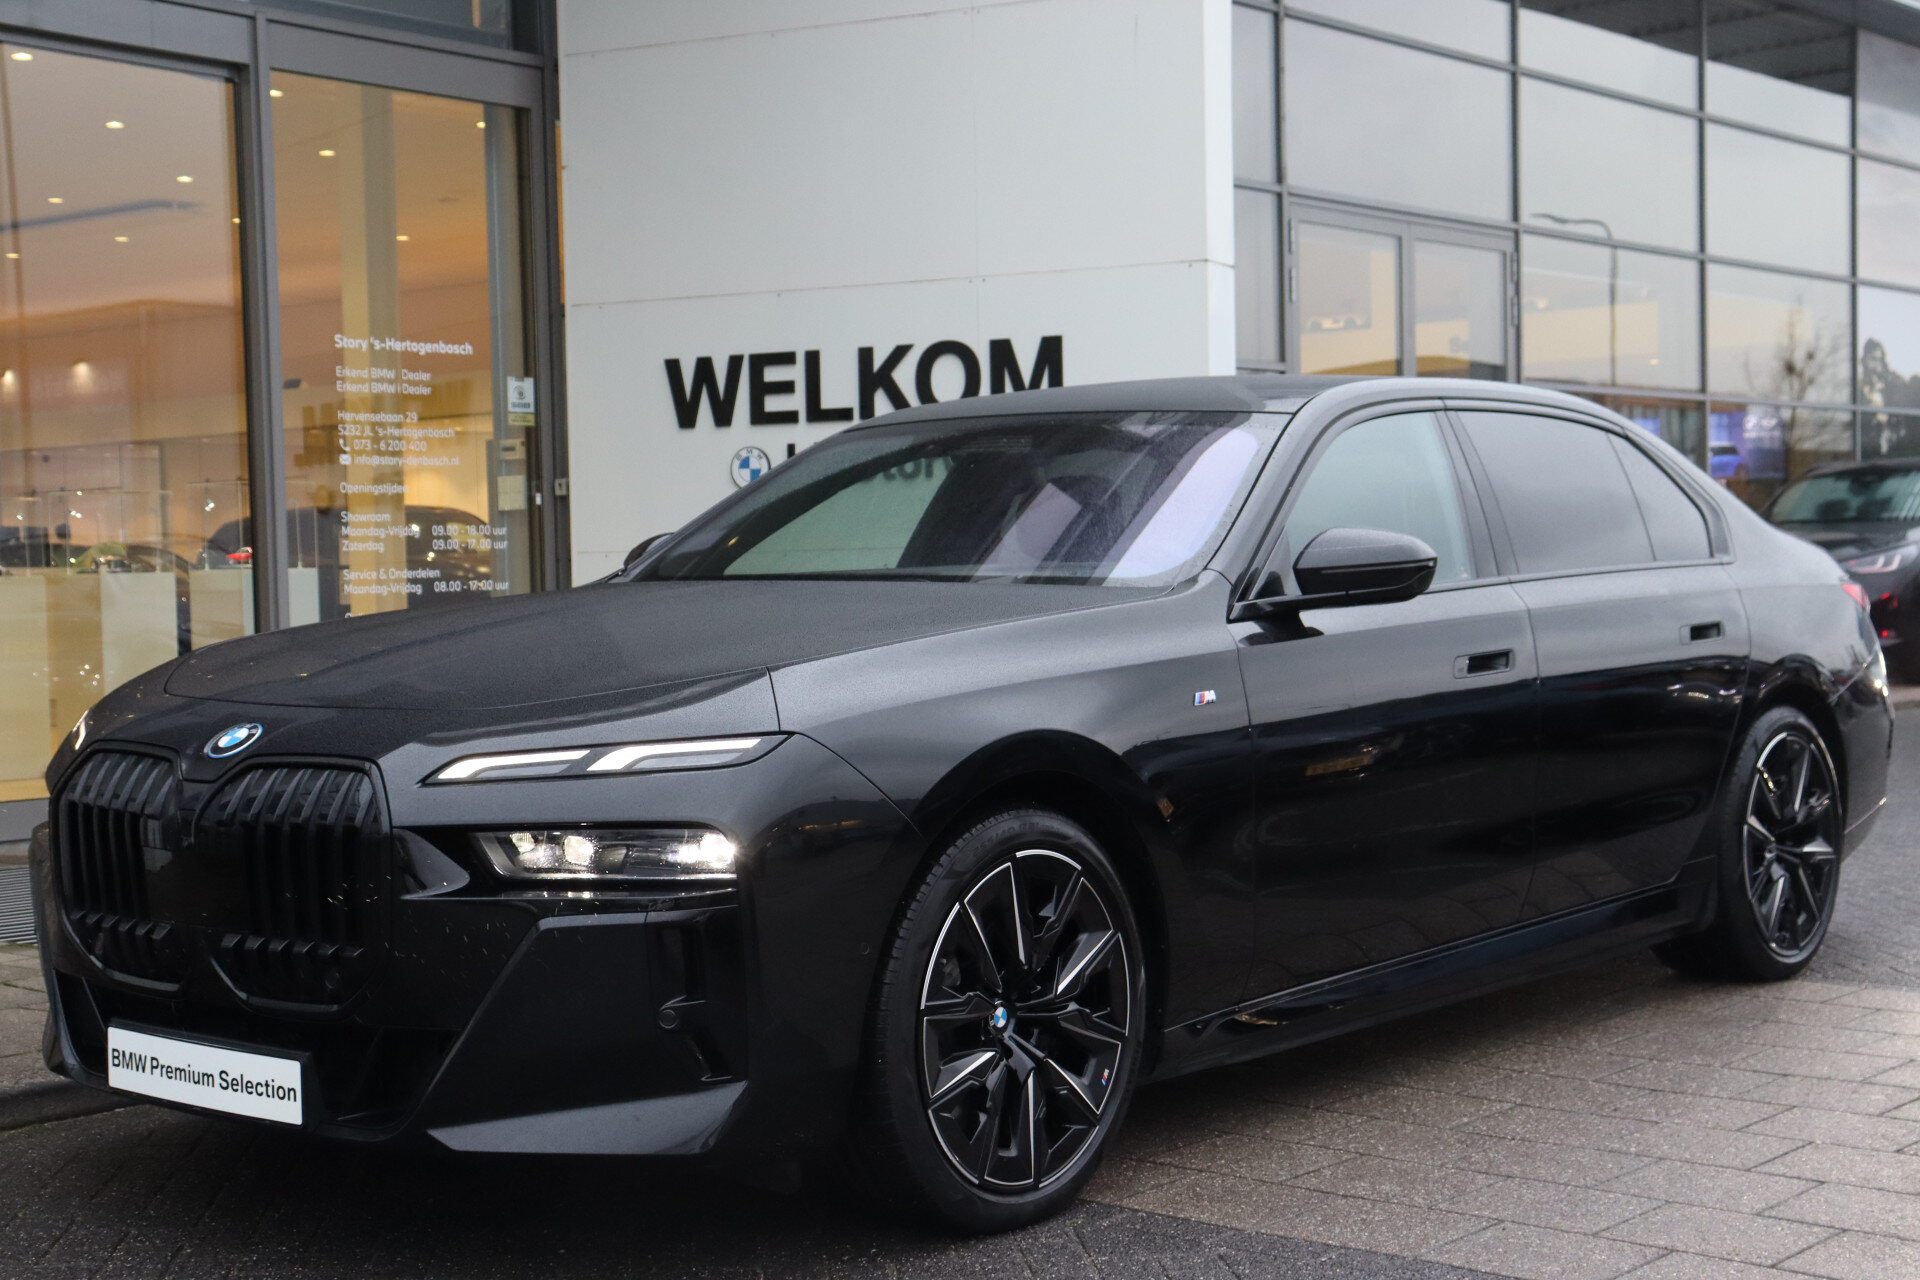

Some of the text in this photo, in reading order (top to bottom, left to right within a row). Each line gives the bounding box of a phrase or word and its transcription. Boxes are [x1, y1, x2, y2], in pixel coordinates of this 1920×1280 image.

[334, 334, 474, 356] Story 's-Hertogenbosch
[335, 365, 432, 381] Erkend BMW Dealer
[336, 380, 369, 393] Erkend
[371, 381, 396, 394] BMW
[402, 383, 432, 395] Dealer
[664, 334, 1064, 429] WELKOM
[337, 410, 419, 423] Hervensebaan 29
[338, 424, 361, 436] 5232
[375, 425, 456, 439] 's-Hertogenbosch
[353, 439, 371, 451] 073
[387, 440, 407, 452] 200
[408, 440, 428, 453] 400
[353, 453, 460, 467] info@story-denbosch.nl
[340, 481, 409, 496] Openingstijden
[340, 510, 391, 523] Showroom
[341, 526, 421, 539] Maandag-Vrijdag
[431, 525, 459, 536] 09.00
[492, 526, 507, 535] uur
[342, 539, 385, 553] Zaterdag
[432, 539, 460, 549] 09.00
[467, 539, 491, 549] 17.00
[492, 540, 508, 549] uur
[343, 568, 441, 580] Service & Onderdelen
[343, 582, 423, 595] Maandag-Vrijdag
[433, 581, 461, 592] 08.00
[494, 581, 509, 591] uur
[111, 1048, 298, 1102] BMW Premium Selection
